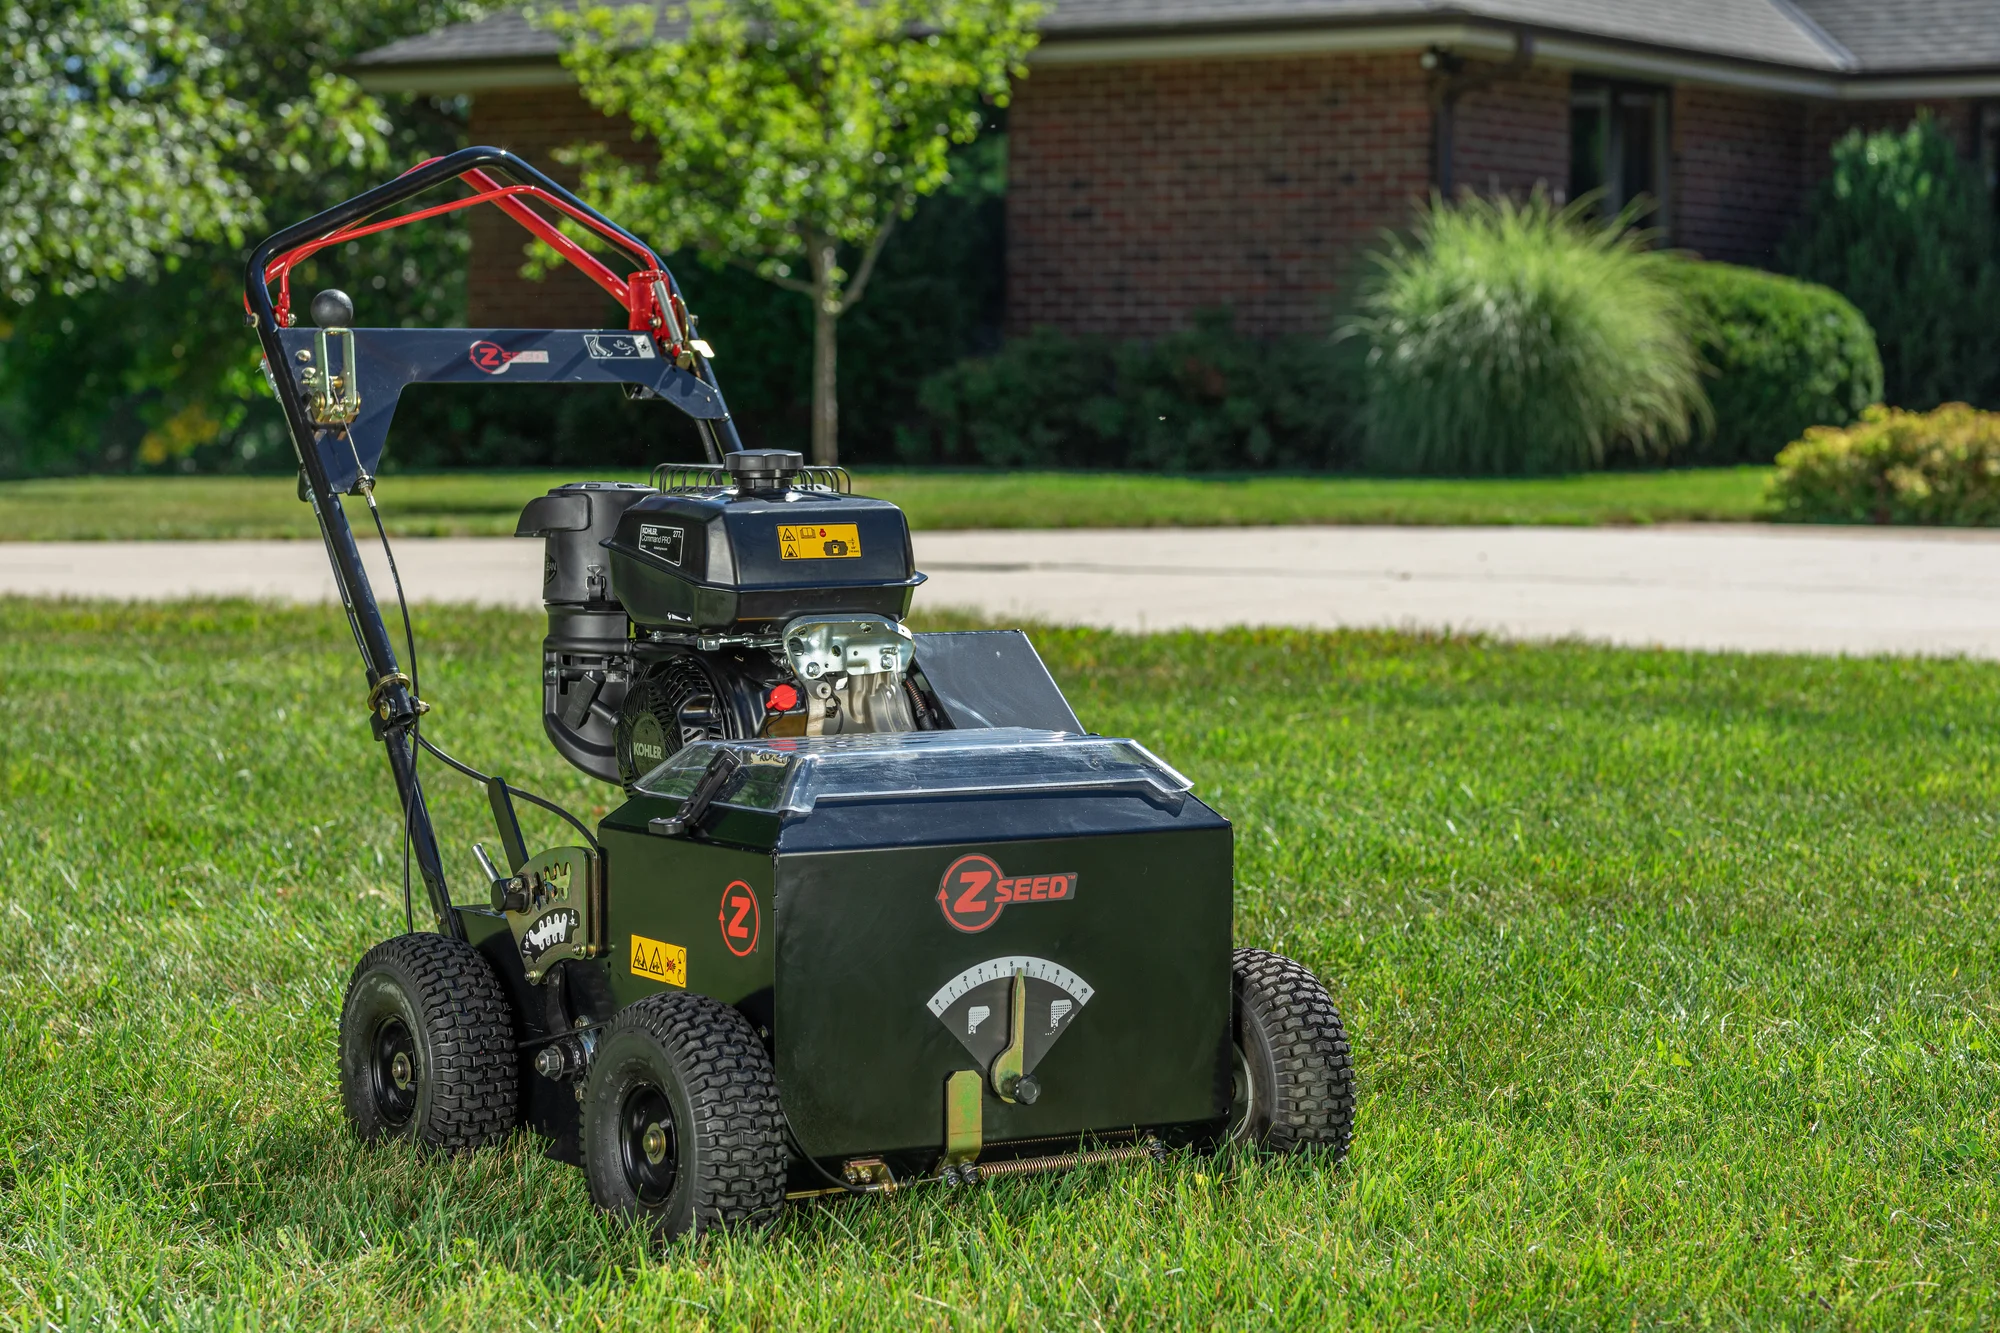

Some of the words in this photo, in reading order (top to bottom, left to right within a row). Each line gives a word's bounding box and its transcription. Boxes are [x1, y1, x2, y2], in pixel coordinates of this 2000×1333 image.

[480, 348, 499, 365] Z
[641, 534, 661, 544] Command
[661, 535, 672, 545] PRO
[642, 527, 658, 535] KOHLER
[633, 742, 662, 760] KOHLER
[953, 870, 993, 913] Z
[993, 875, 1069, 903] SEED
[728, 896, 751, 939] Z
